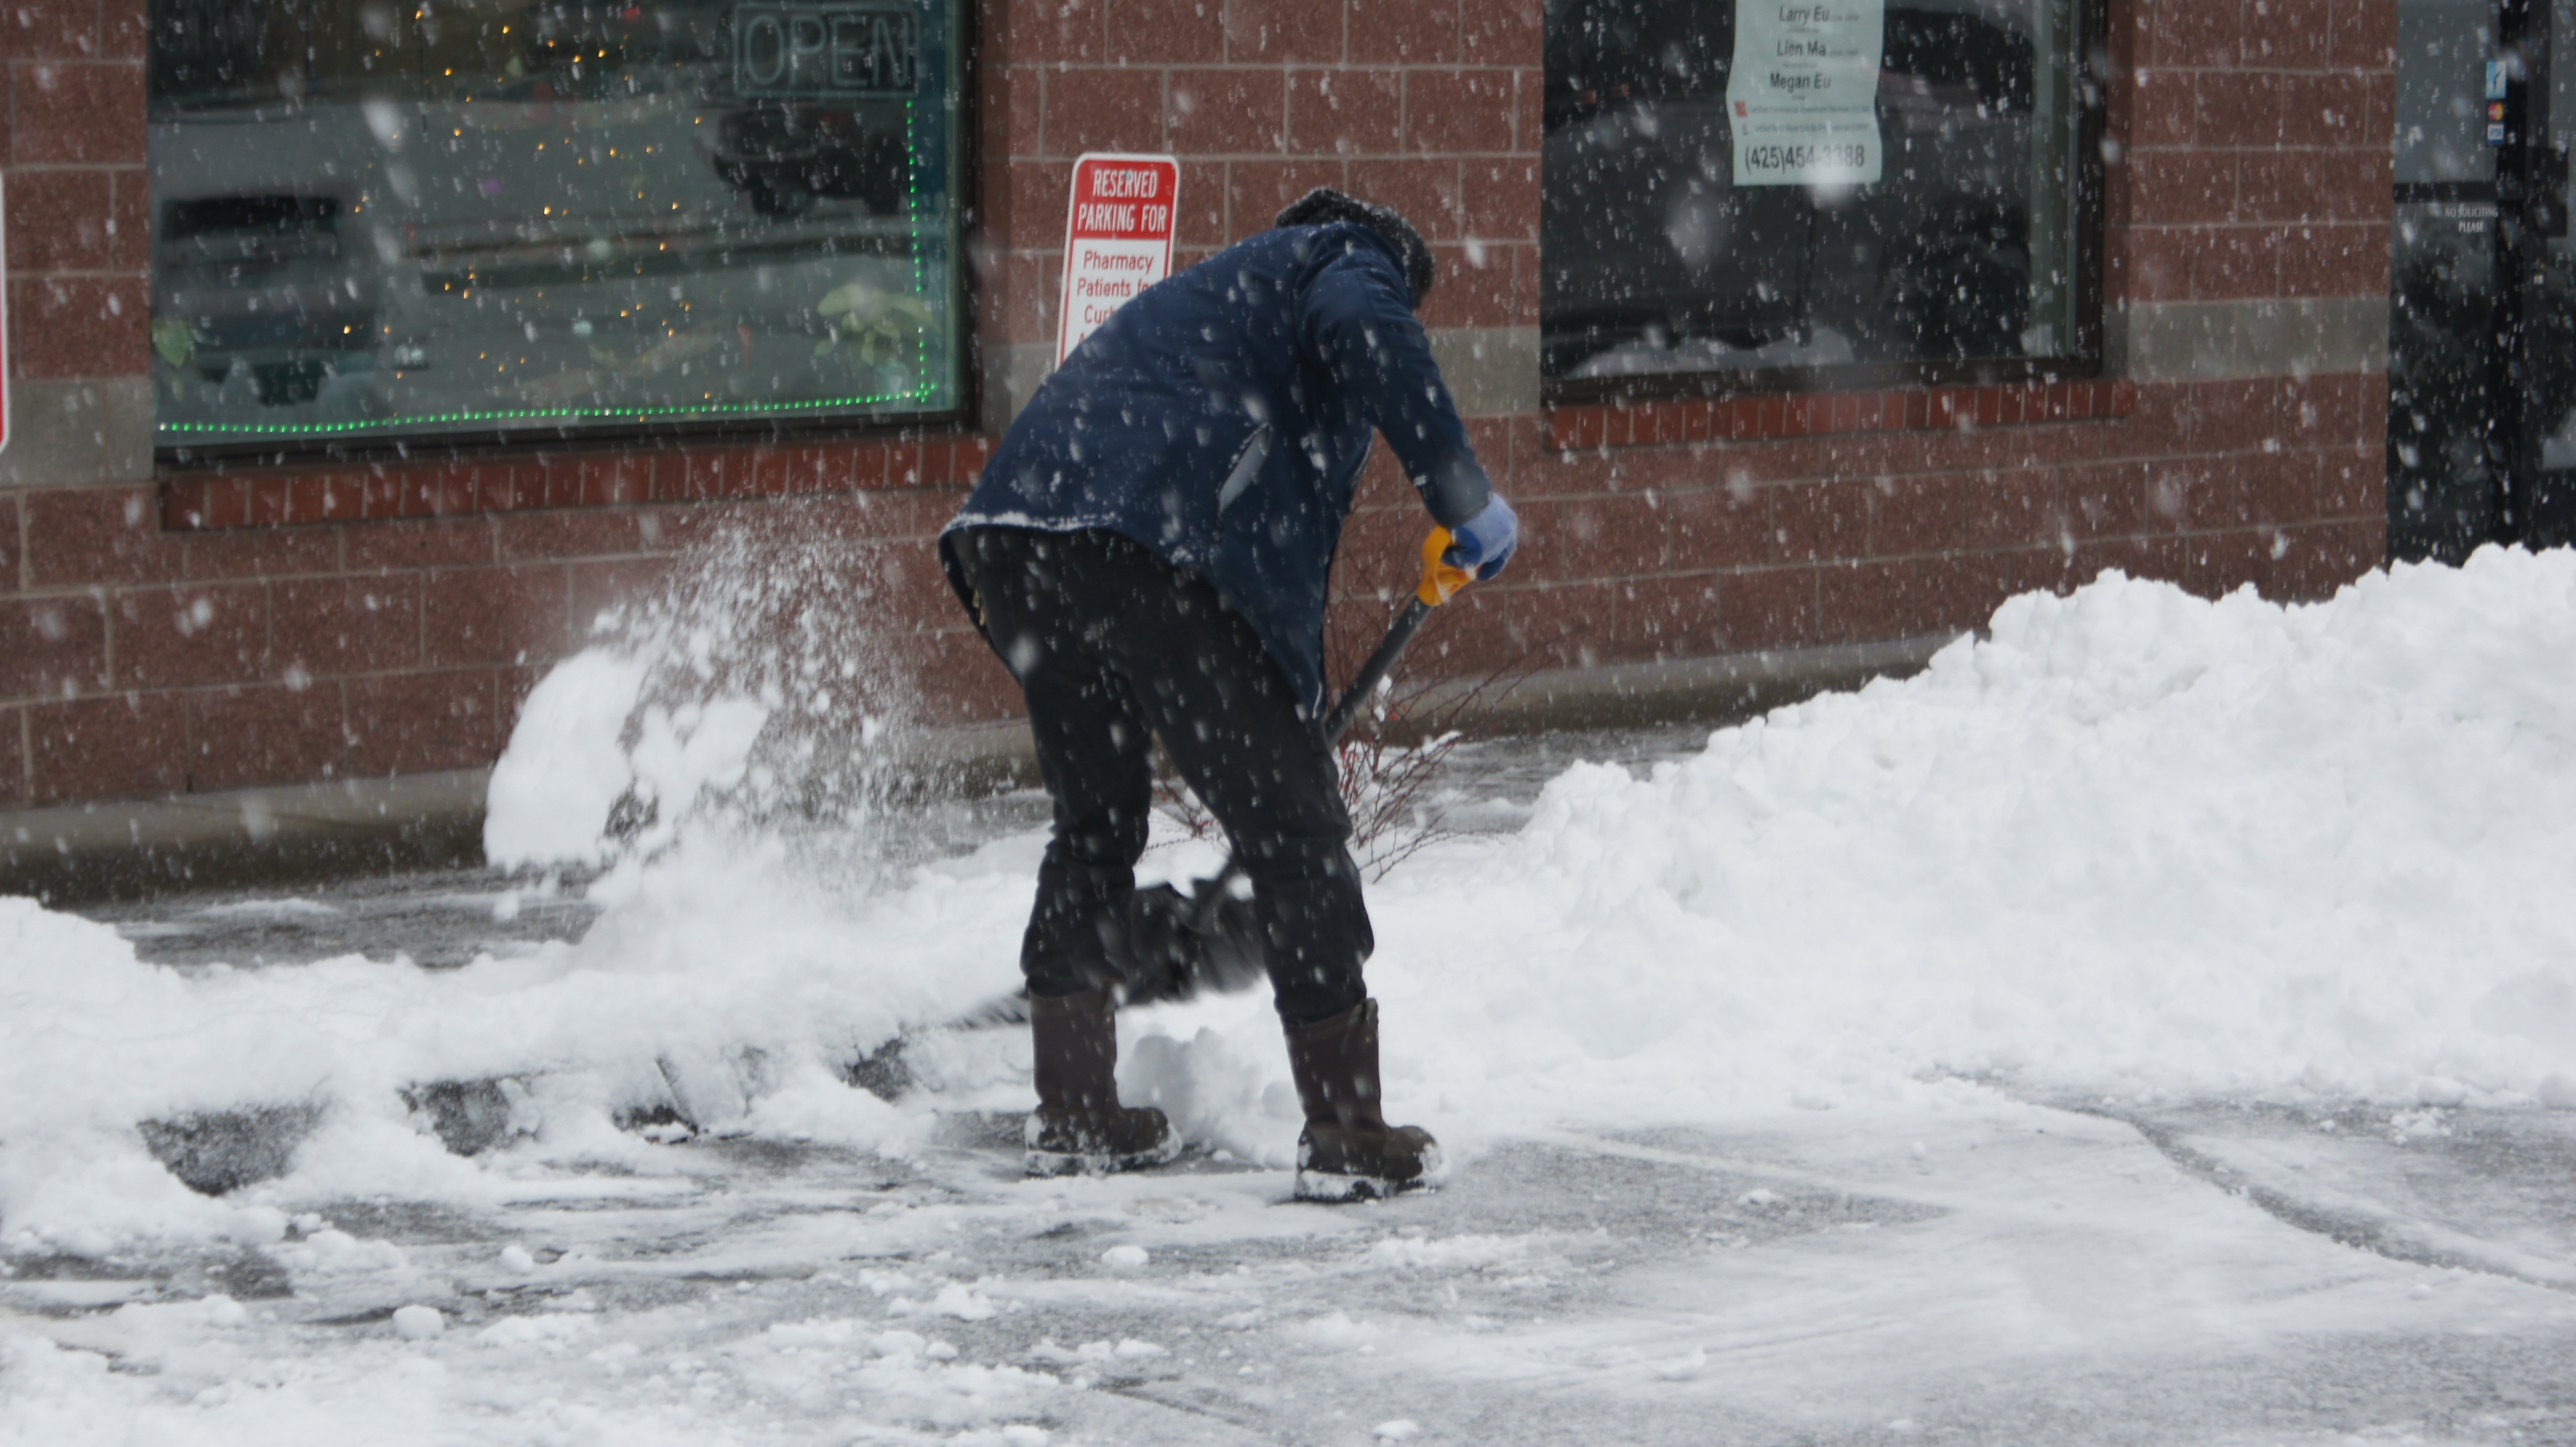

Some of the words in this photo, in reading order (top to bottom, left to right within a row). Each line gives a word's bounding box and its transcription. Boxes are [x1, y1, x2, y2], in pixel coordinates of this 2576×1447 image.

[1779, 6, 1810, 26] Larry
[1813, 5, 1830, 22] Eu
[745, 14, 908, 87] OPEN
[1807, 40, 1827, 57] Ma
[1769, 72, 1810, 93] Megan
[1813, 72, 1832, 90] Eu
[1092, 169, 1158, 199] RESERVED
[1077, 203, 1135, 232] PARKING
[1140, 204, 1167, 233] FOR
[2444, 207, 2456, 218] NO
[2458, 206, 2498, 218] SOLICITING
[2458, 220, 2484, 233] PLEASE
[1083, 250, 1154, 275] Pharmacy
[1077, 277, 1131, 298] Patients
